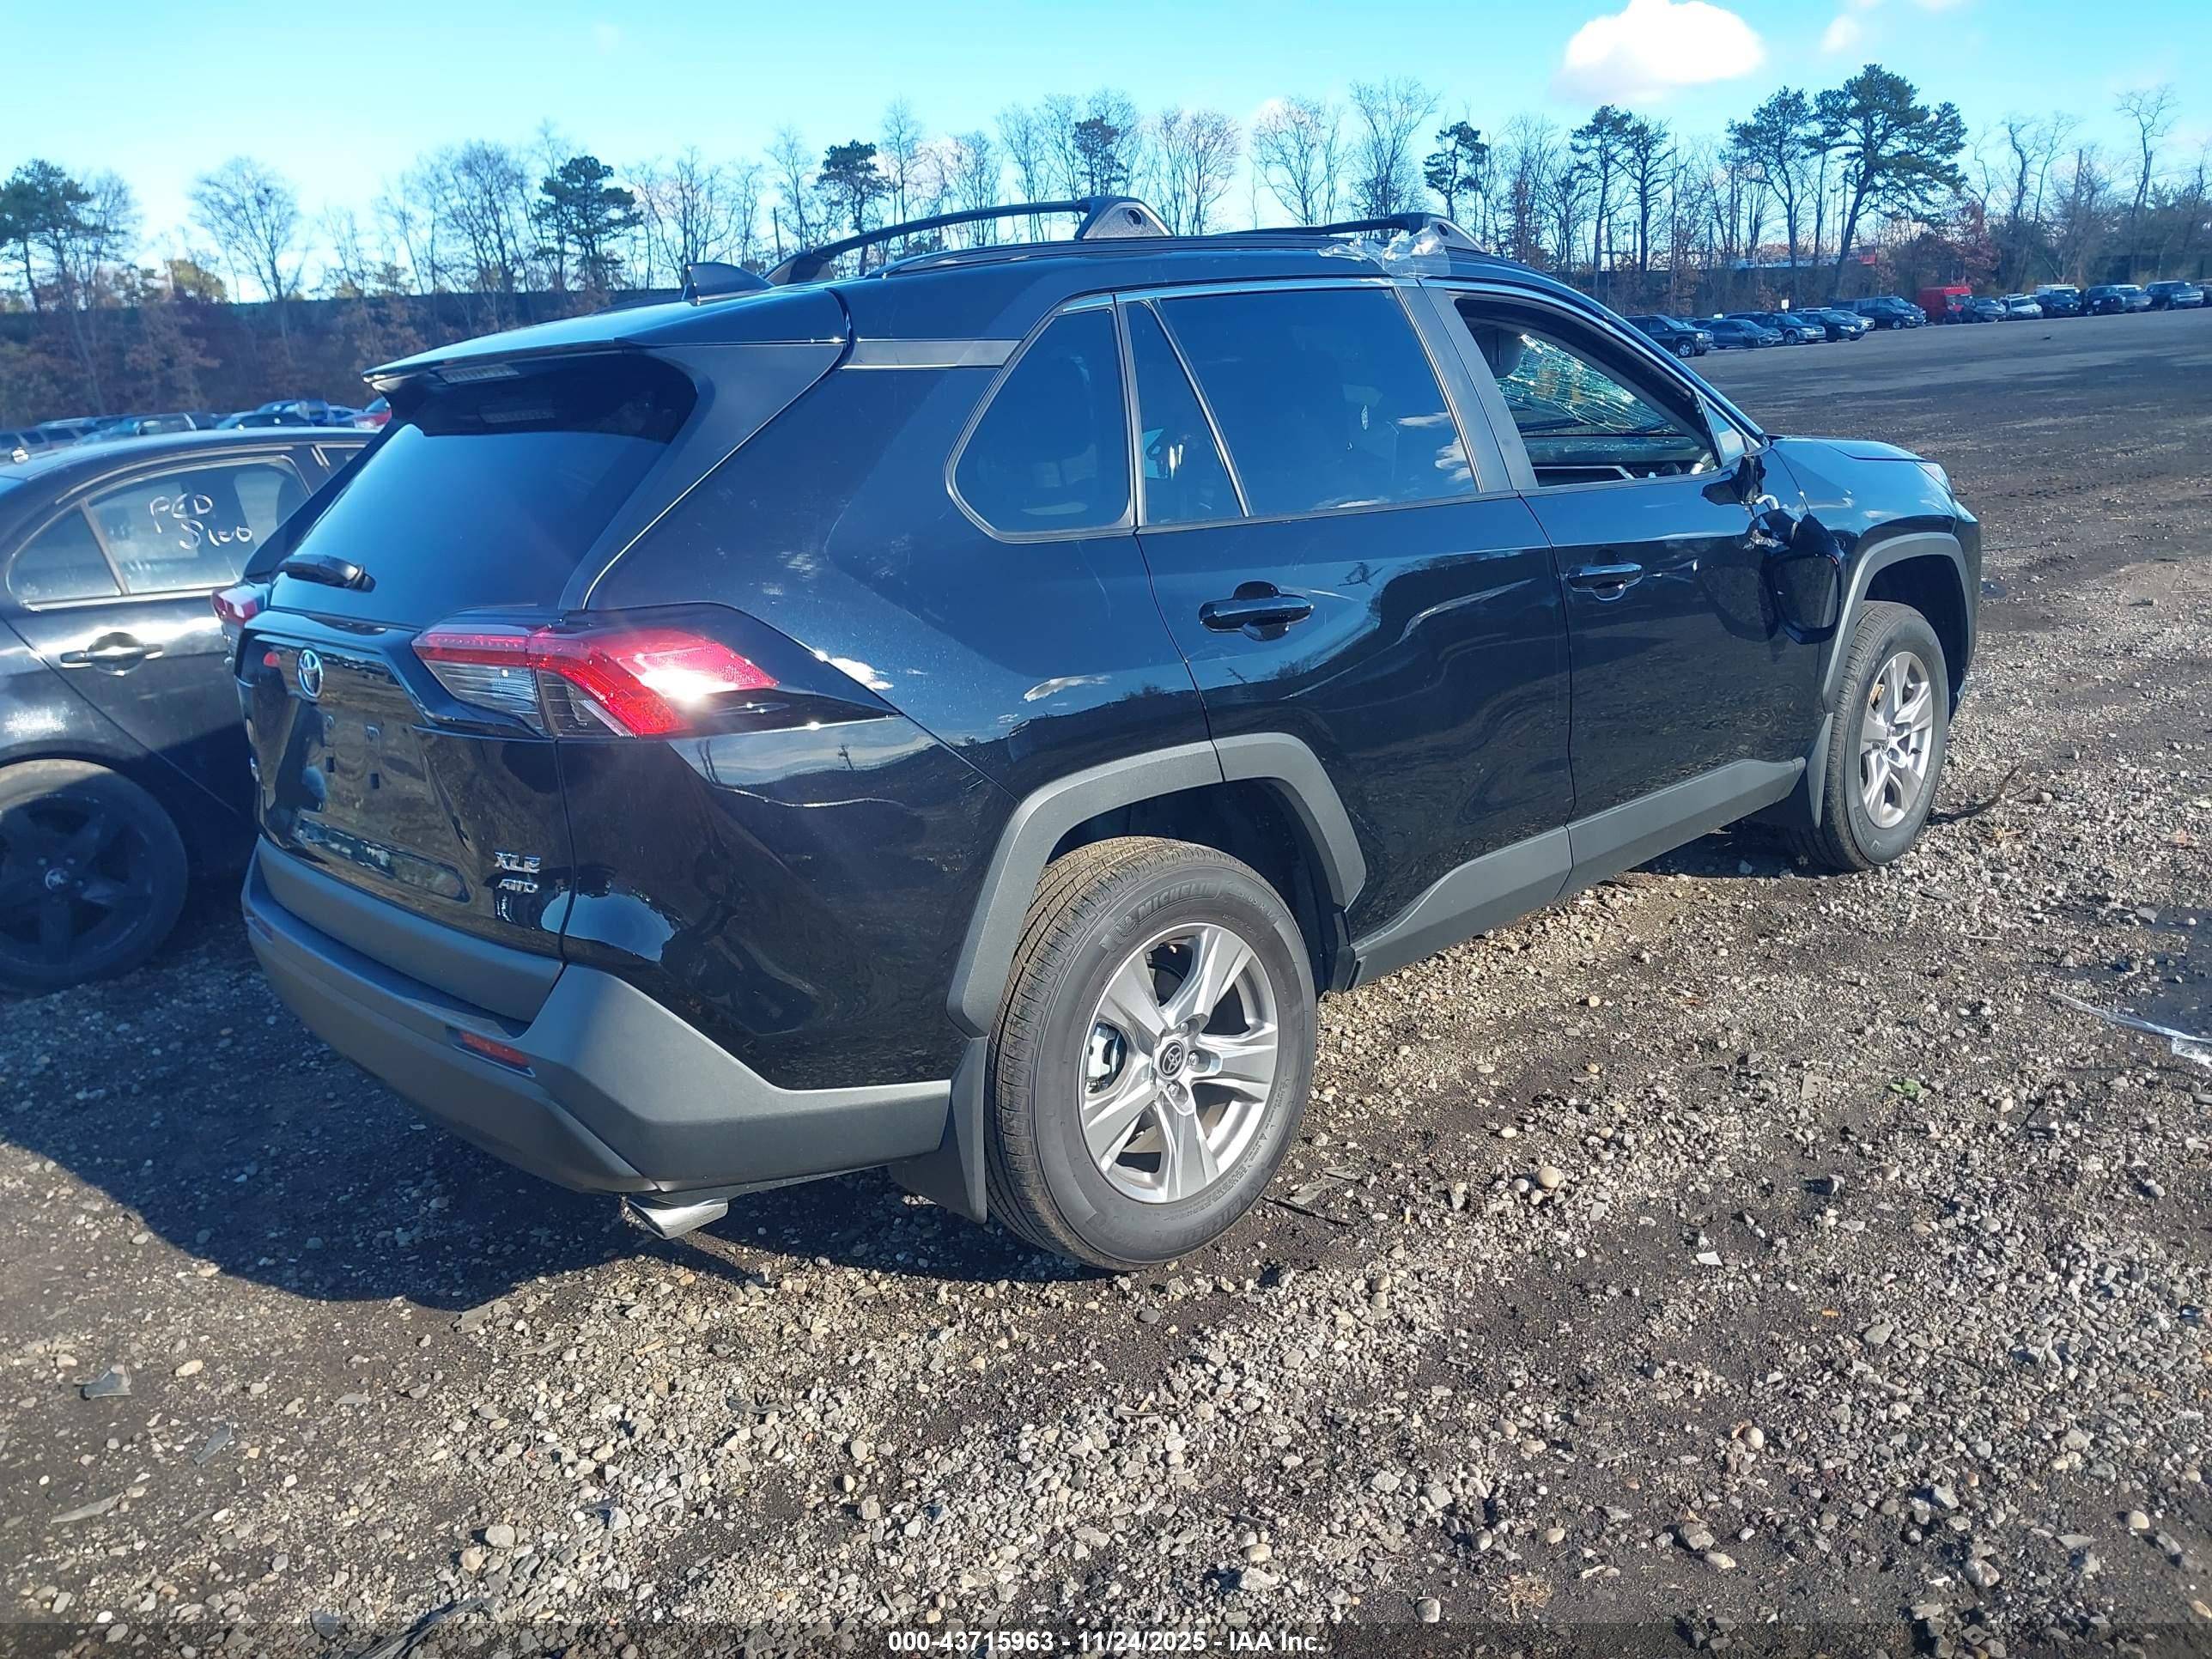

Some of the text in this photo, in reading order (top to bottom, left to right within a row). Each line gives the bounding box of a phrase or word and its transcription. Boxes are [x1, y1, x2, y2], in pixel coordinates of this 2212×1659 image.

[495, 851, 541, 874] XLE
[498, 878, 538, 893] AWD
[1138, 882, 1218, 921] MICHELIN
